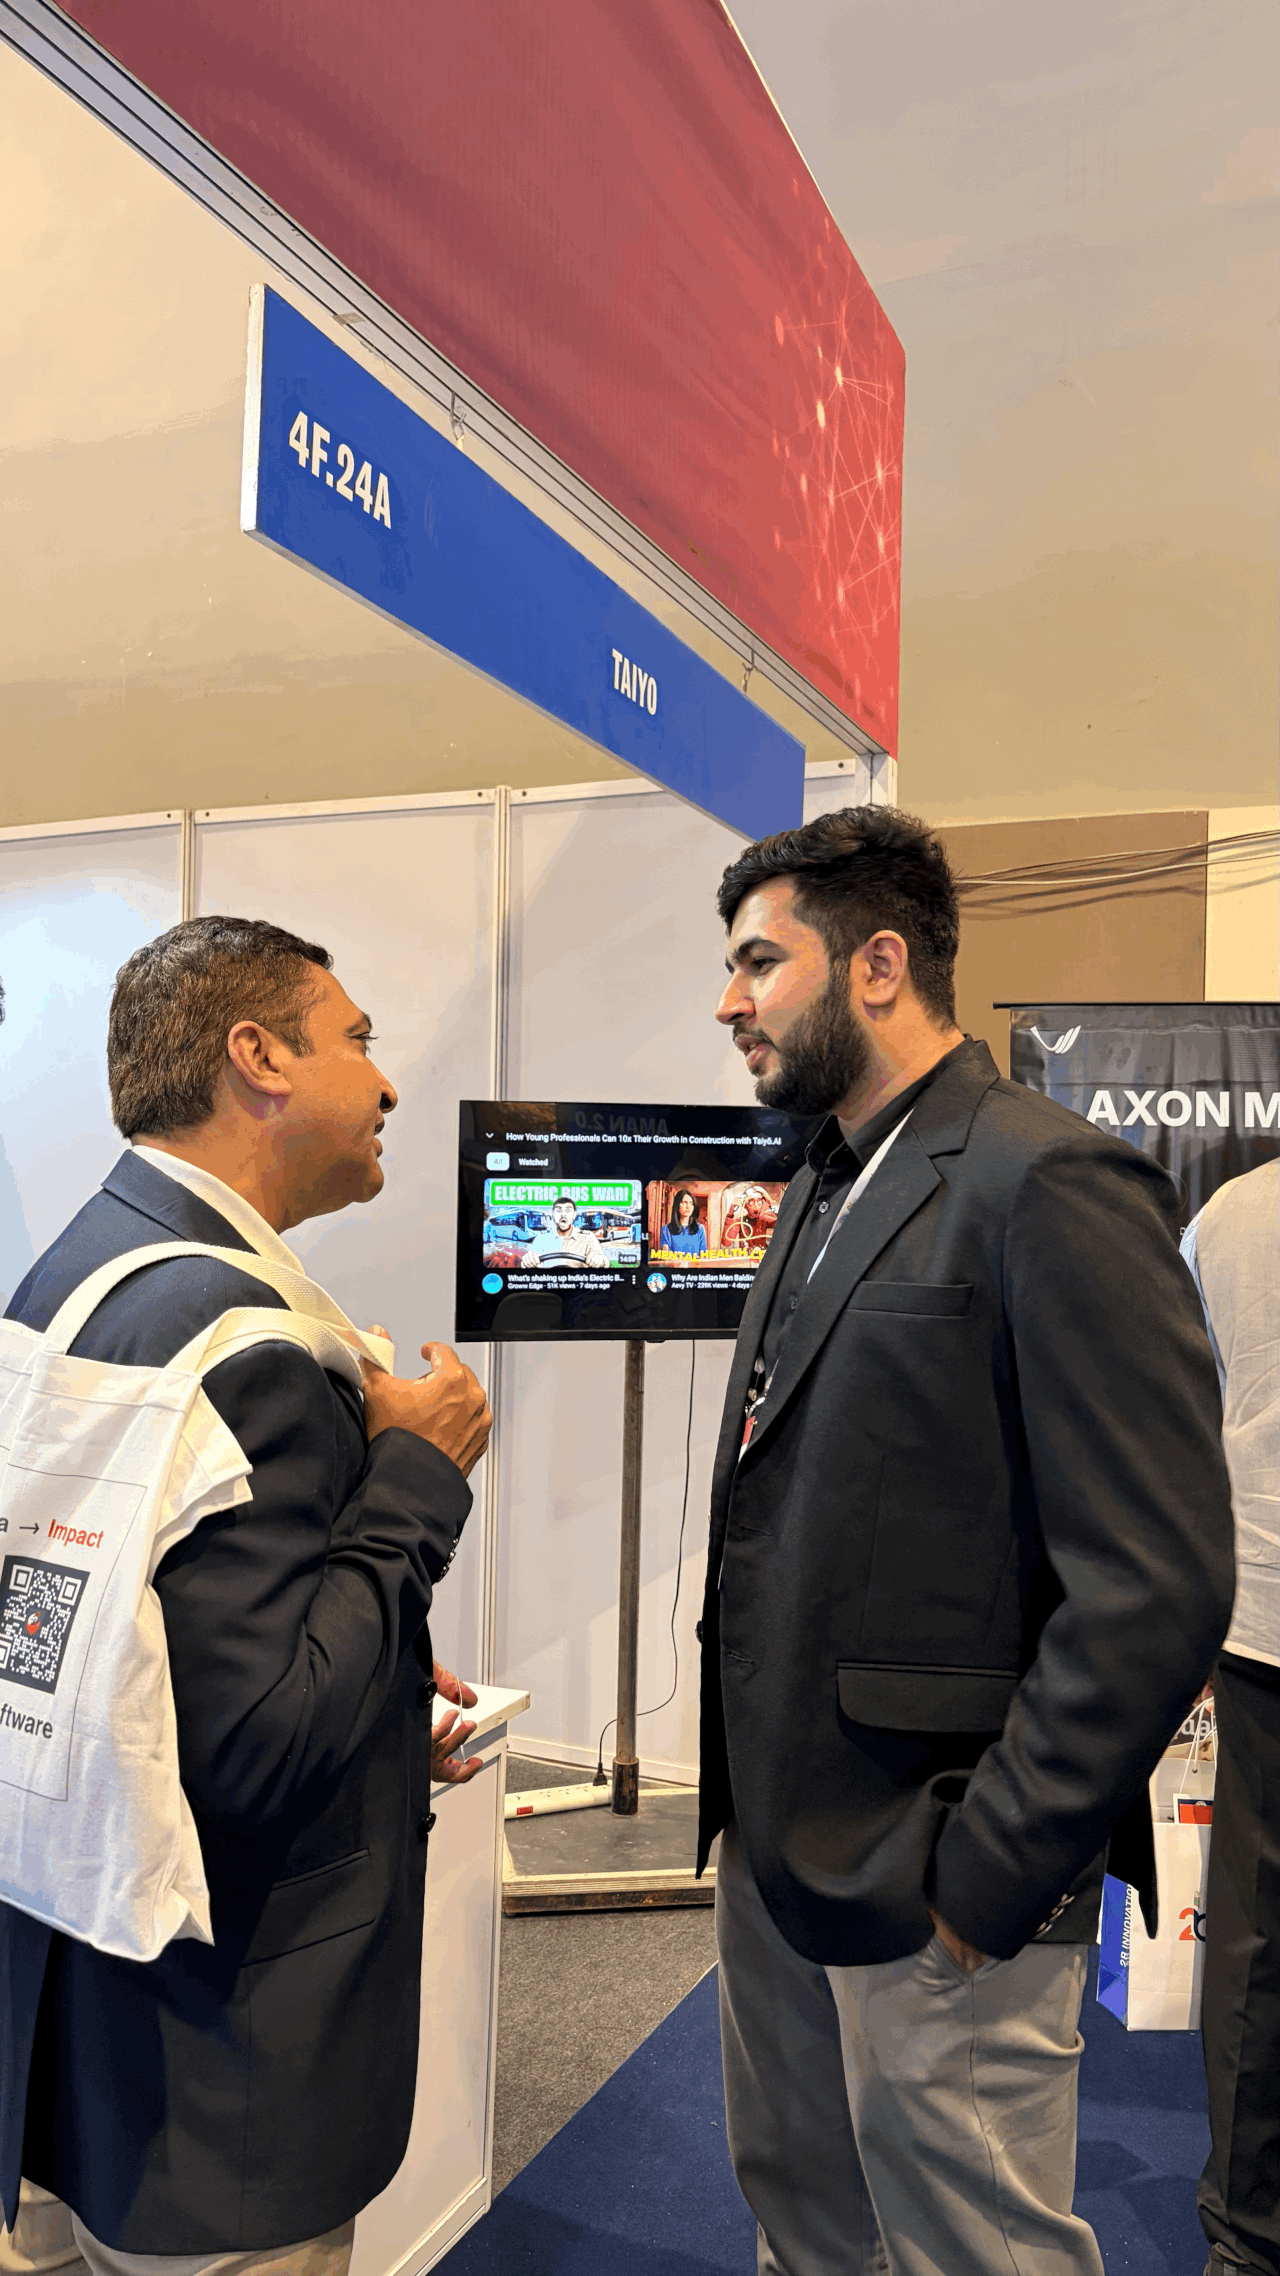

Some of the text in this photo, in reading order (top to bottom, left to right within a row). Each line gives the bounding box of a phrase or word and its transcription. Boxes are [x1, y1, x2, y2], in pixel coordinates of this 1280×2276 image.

[288, 411, 391, 529] 4F.24A
[611, 648, 658, 715] TAIYO
[1086, 1090, 1230, 1127] AXON
[506, 1132, 524, 1141] How
[525, 1133, 549, 1143] Young
[550, 1133, 600, 1142] Professionals
[602, 1134, 616, 1142] Can
[633, 1135, 652, 1143] Their
[653, 1135, 679, 1143] Growth
[689, 1136, 735, 1144] Construction
[736, 1136, 751, 1144] with
[519, 1158, 548, 1166] Watched
[495, 1186, 629, 1202] ELECTRIC BUS WAR!
[651, 1249, 699, 1262] MENTAL
[700, 1248, 747, 1259] HEALTH
[508, 1274, 530, 1282] What's
[531, 1274, 557, 1283] shaking
[558, 1275, 567, 1283] up
[671, 1274, 685, 1282] Why
[48, 1519, 103, 1548] Impact
